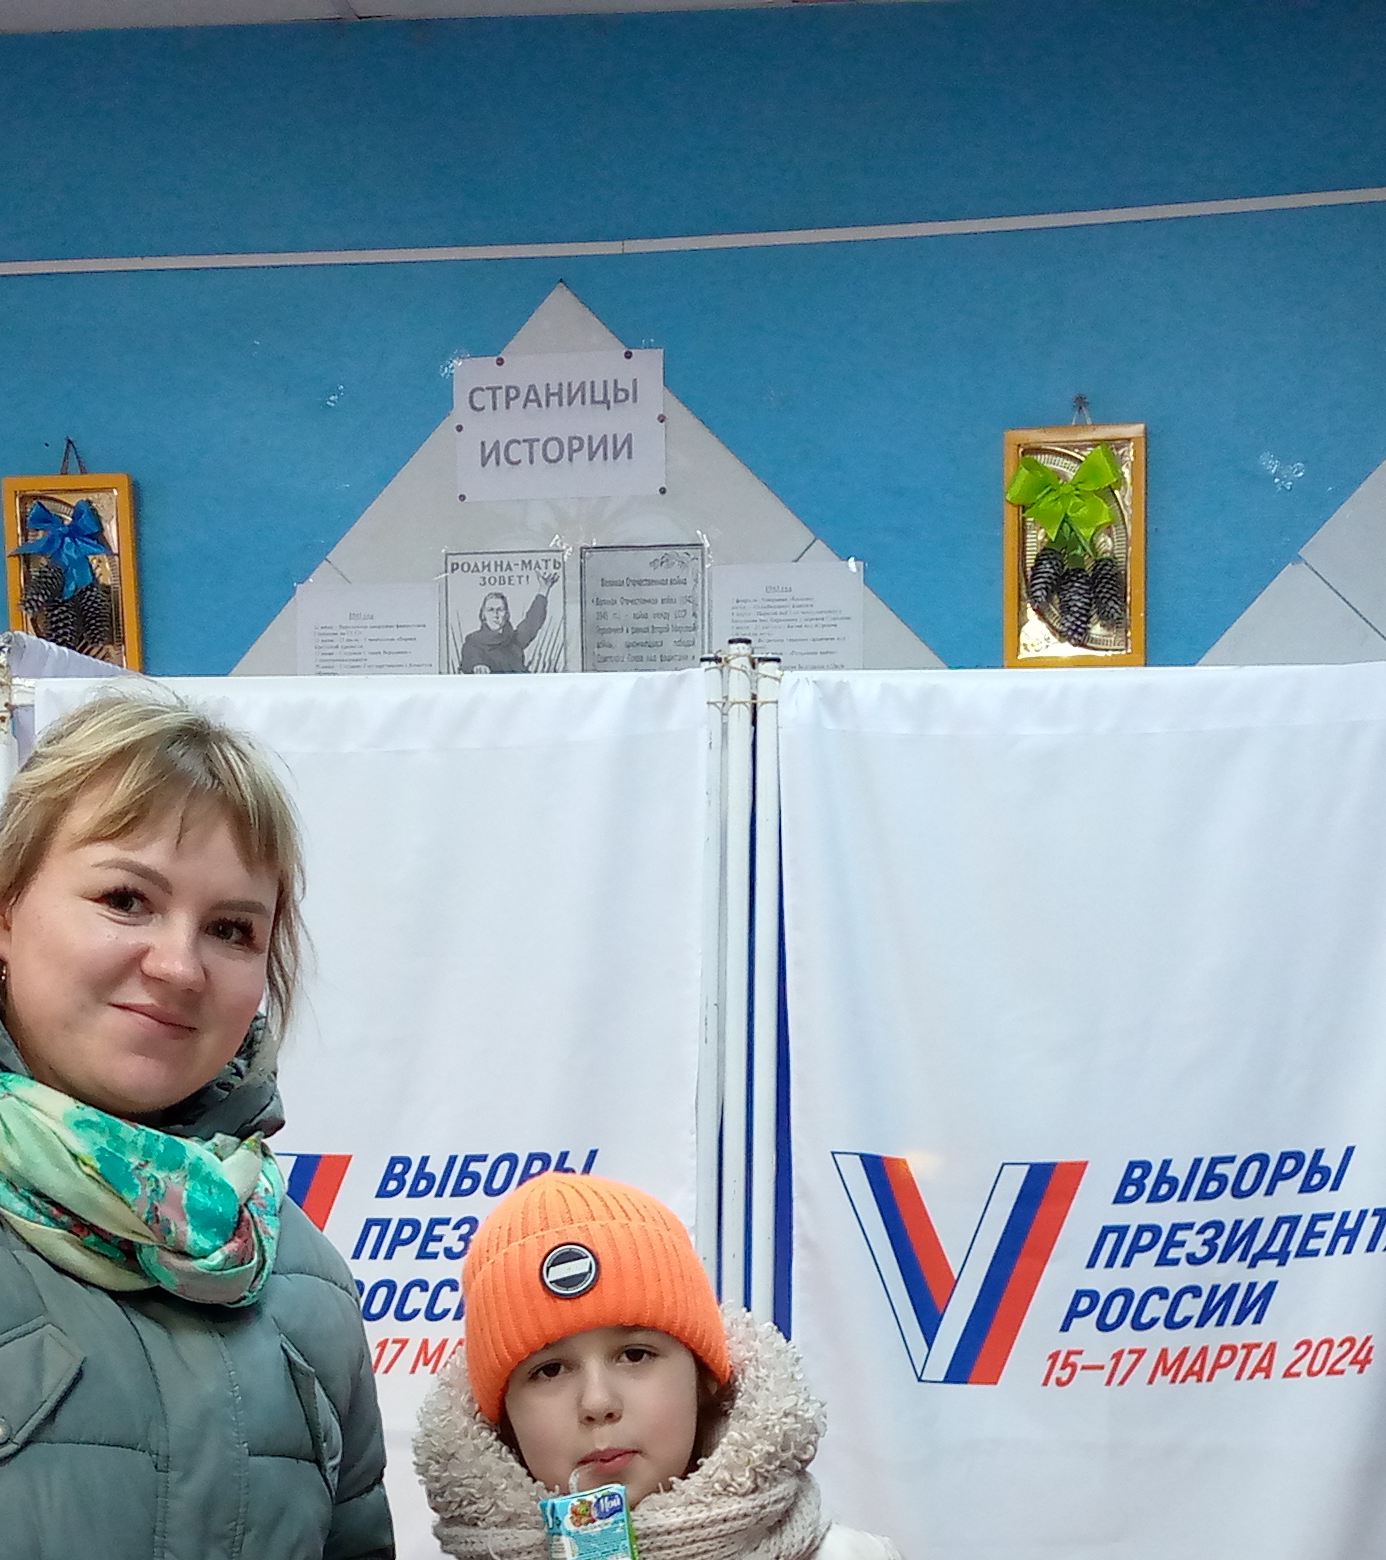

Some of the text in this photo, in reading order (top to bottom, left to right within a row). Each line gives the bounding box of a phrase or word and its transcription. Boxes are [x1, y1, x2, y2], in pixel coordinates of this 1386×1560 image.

[468, 378, 638, 412] СТРАНИЦЫ
[480, 432, 633, 468] ИСТОРИИ
[451, 558, 561, 574] РОДИНА-МАТЬ
[479, 575, 530, 586] ЗОВЕТ!
[1111, 1146, 1356, 1206] ВЫБОРЫ
[1060, 1280, 1278, 1334] РОССИИ
[1040, 1334, 1374, 1387] 15–17 МАРТА 2024
